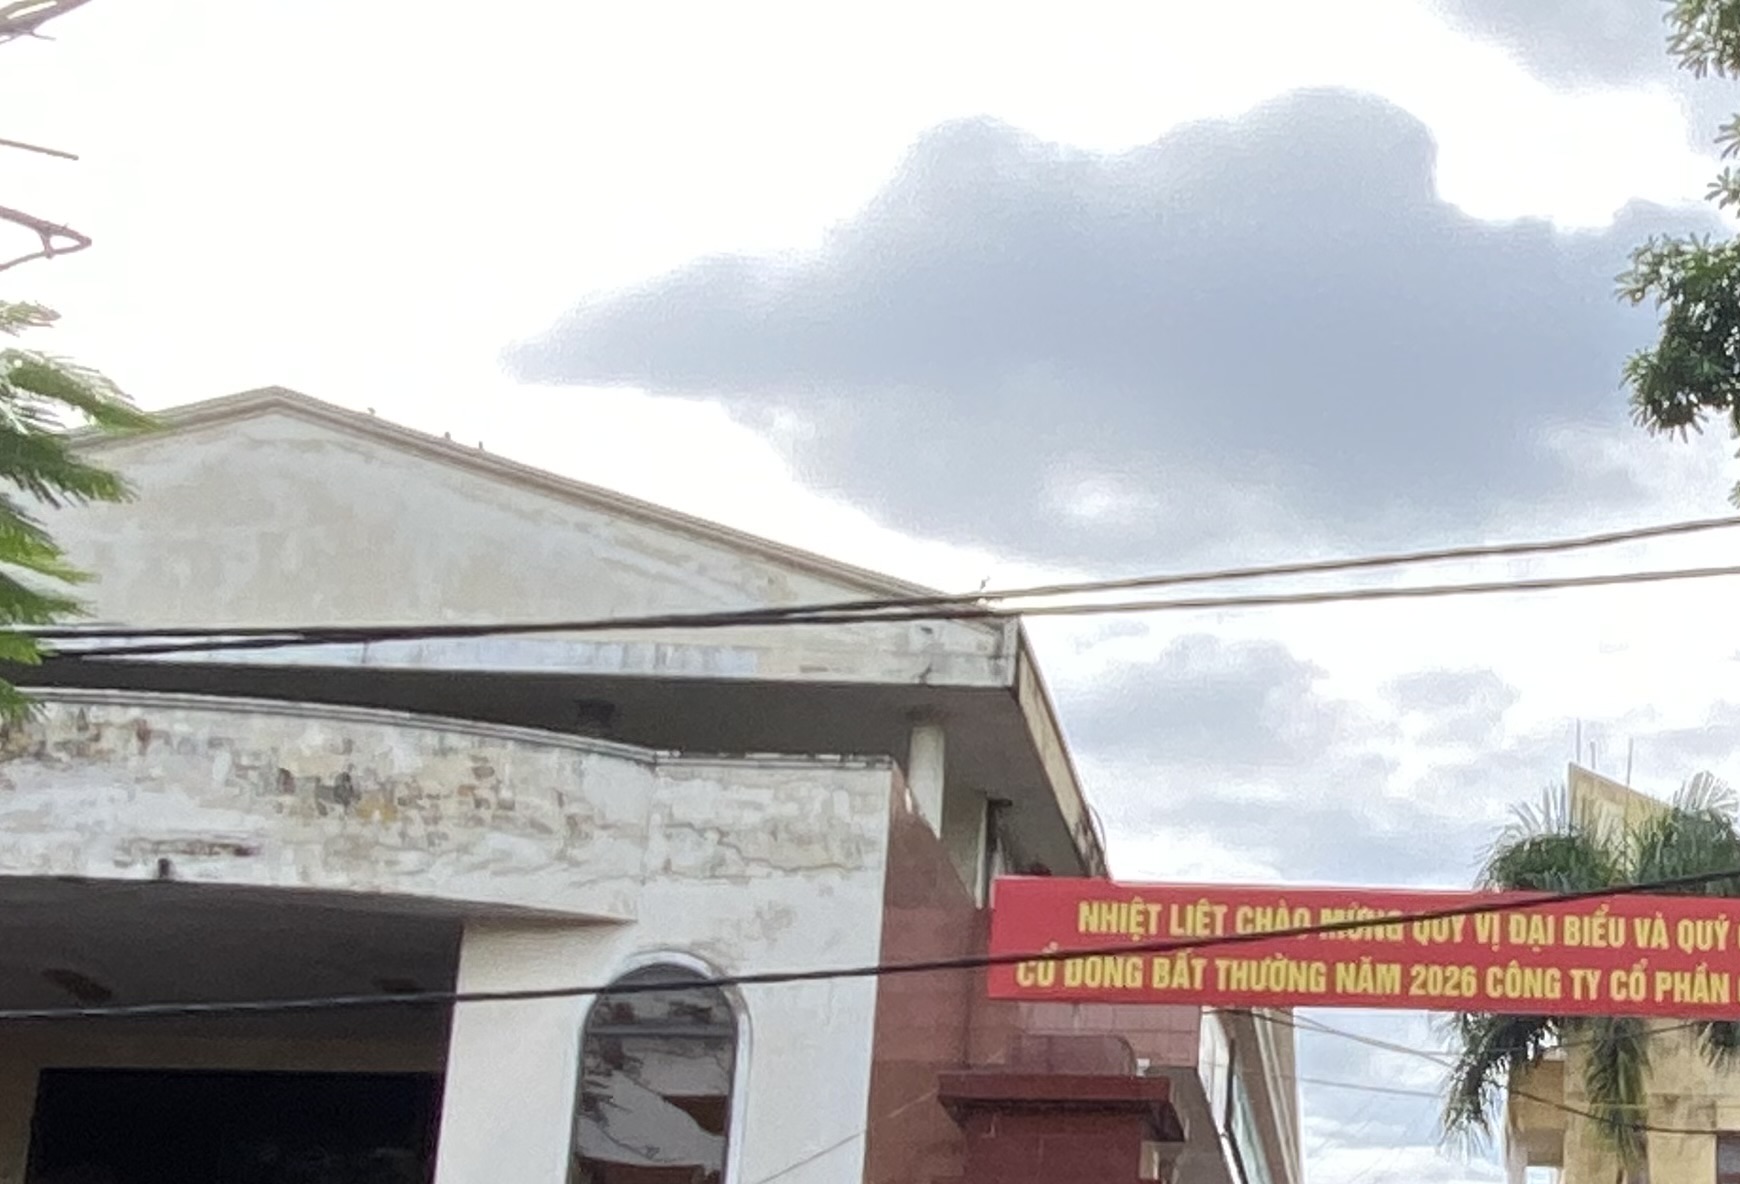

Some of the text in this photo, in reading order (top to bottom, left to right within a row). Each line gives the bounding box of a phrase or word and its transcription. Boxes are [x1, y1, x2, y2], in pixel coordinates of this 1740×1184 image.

[1078, 896, 1162, 943] NHIỆT
[1473, 912, 1501, 950] VỊ
[1508, 912, 1555, 952] ĐẠI
[1563, 904, 1626, 948] BIỂU
[1633, 913, 1670, 950] VÀ
[1676, 914, 1730, 954] QUÝ
[1152, 947, 1208, 990] BẤT
[1214, 954, 1327, 993] THƯỜNG
[1335, 956, 1402, 995] NĂM
[1409, 964, 1477, 997] 2026
[1486, 960, 1562, 999] CÔNG
[1570, 969, 1601, 1000] TY
[1610, 959, 1647, 1002] CỔ
[1654, 962, 1730, 1004] PHẦN
